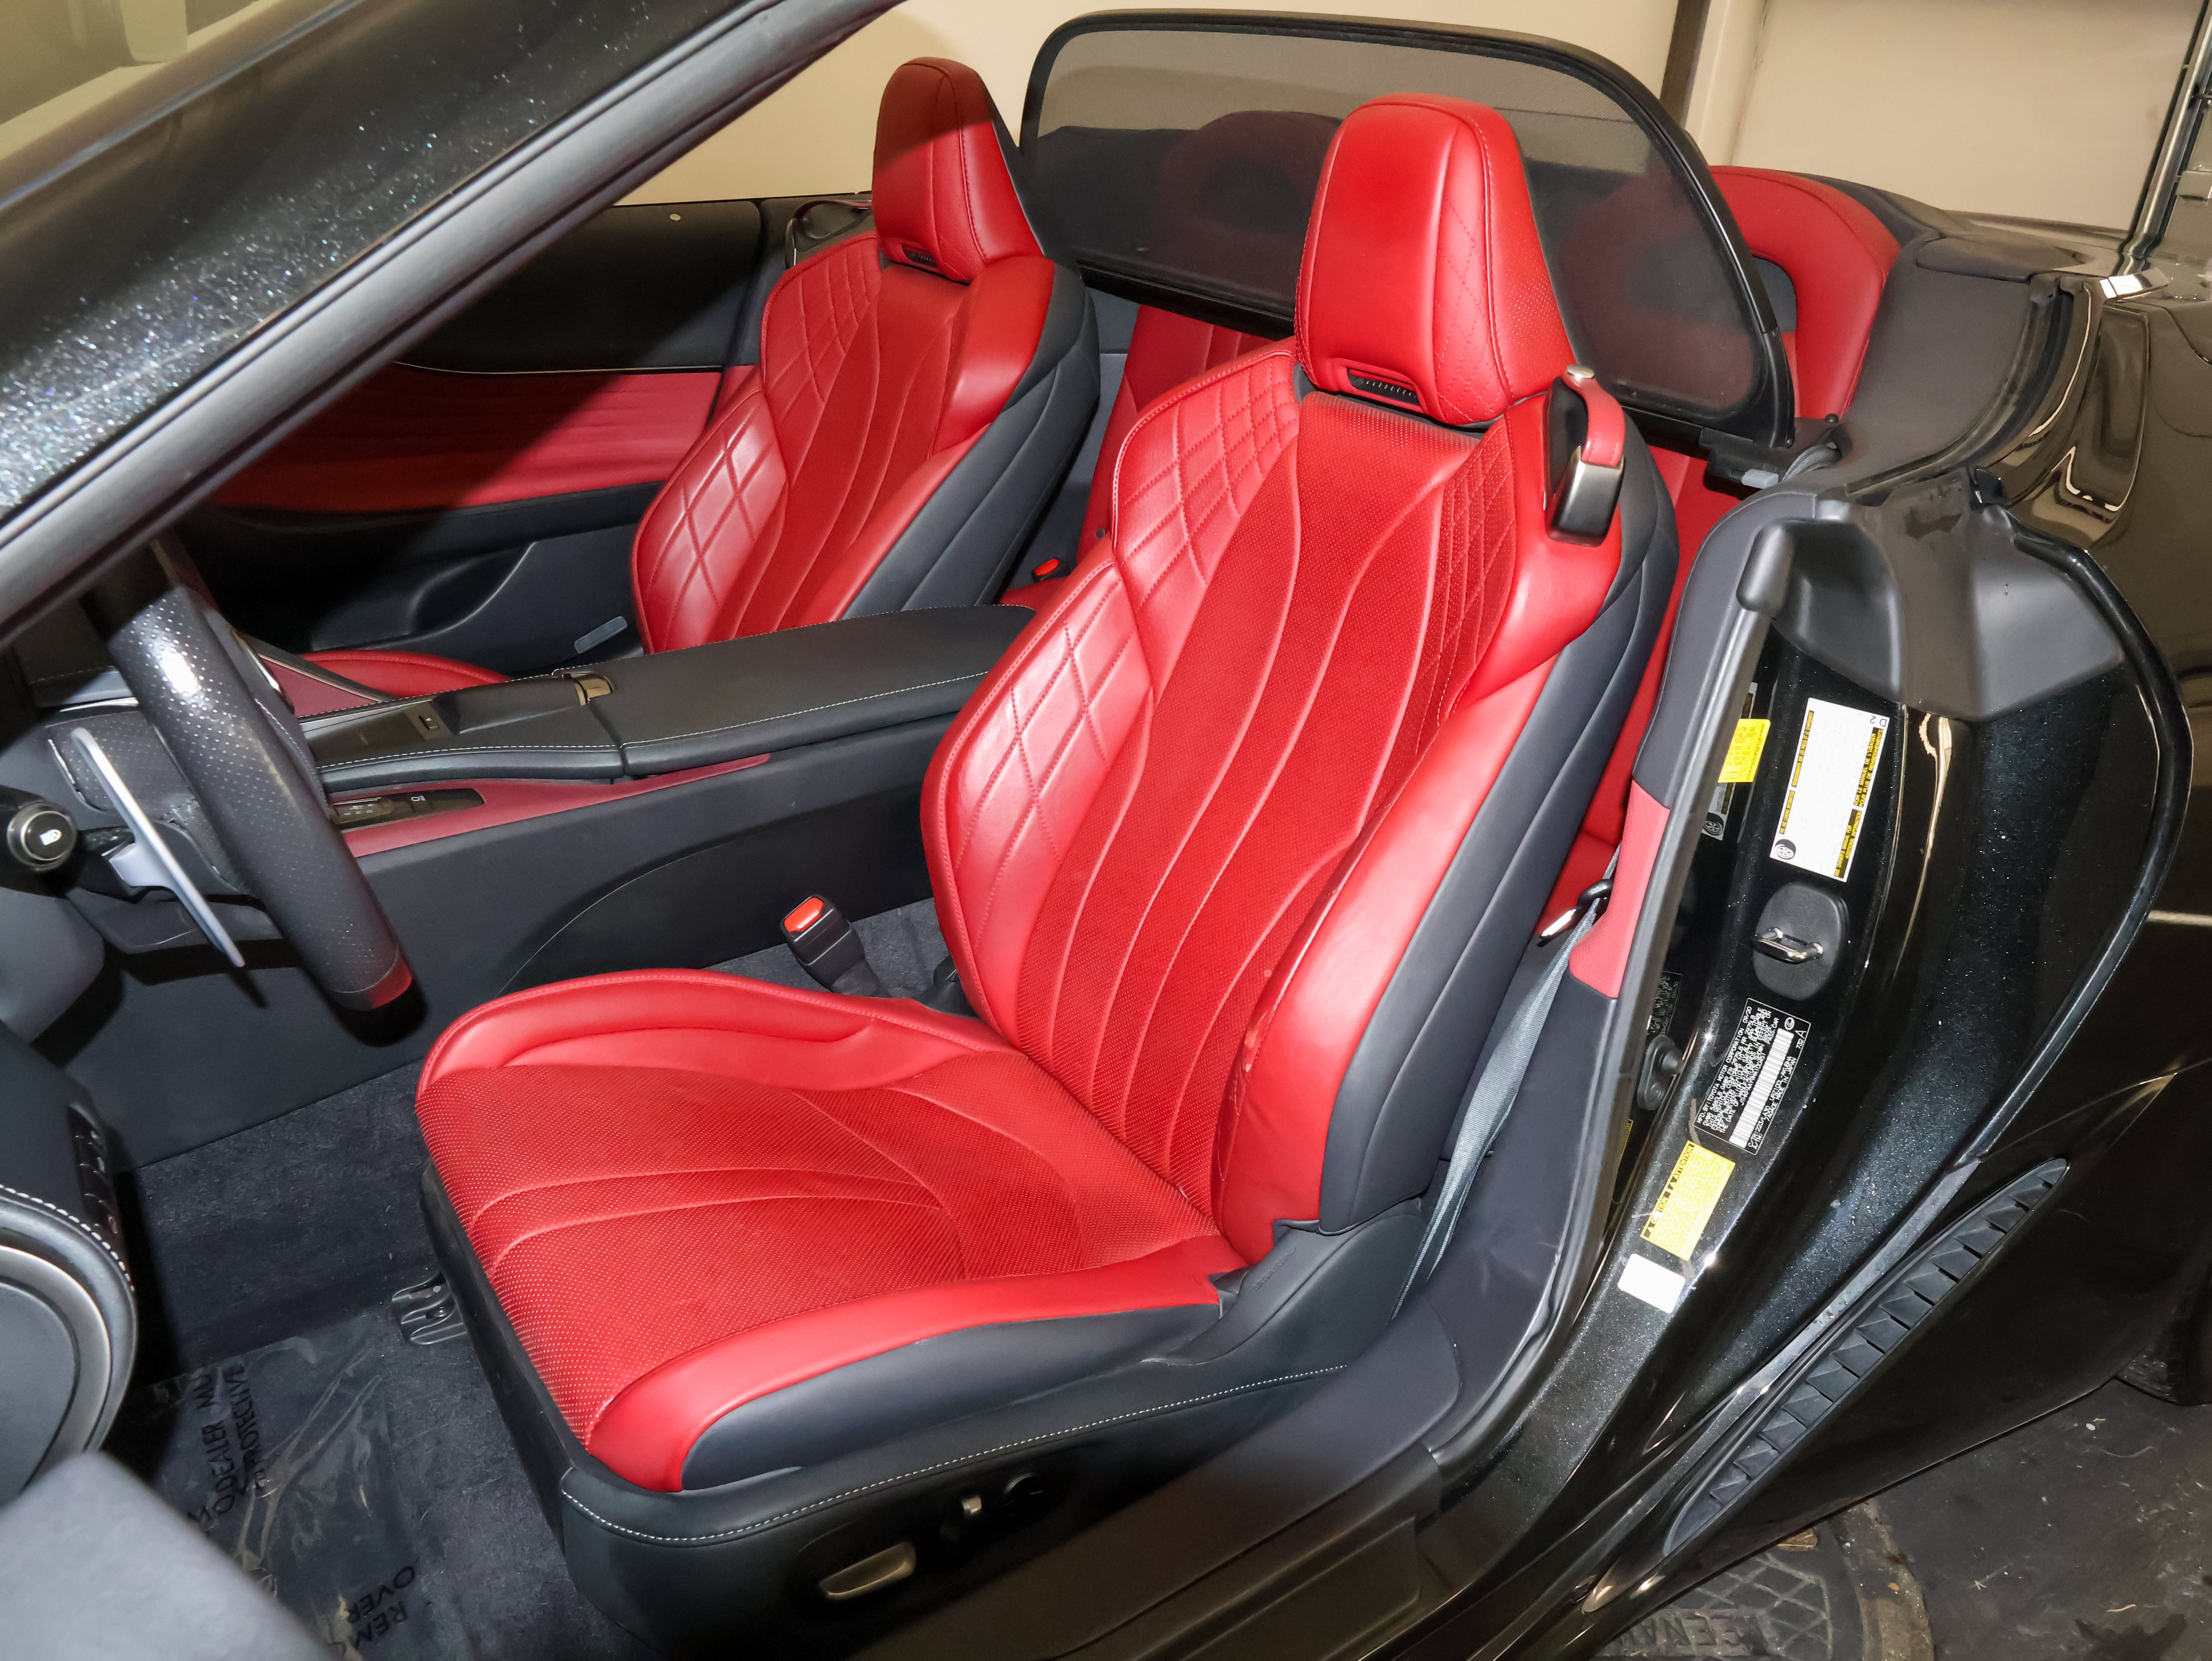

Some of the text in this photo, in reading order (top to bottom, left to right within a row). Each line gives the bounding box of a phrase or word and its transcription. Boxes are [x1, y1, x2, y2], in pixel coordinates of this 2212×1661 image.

[1868, 728, 1883, 771] RENSEIGNEMENTS
[1869, 715, 1876, 724] 2
[1859, 765, 1868, 786] MANUEL
[1866, 733, 1877, 756] L'USAGER
[1845, 810, 1862, 859] ADDITIONAL INFORMATION
[1702, 1111, 1713, 1126] GVWR
[1719, 1075, 1730, 1090] GAWR
[1726, 1066, 1734, 1075] FR
[1730, 1045, 1744, 1066] 2975LB
[1740, 1035, 1748, 1044] RR
[1744, 1014, 1756, 1035] 2975LB
[1706, 1113, 1717, 1128] THIS
[1713, 1089, 1729, 1113] VEHICLE
[1725, 1062, 1741, 1089] CONFORMS
[1738, 1053, 1745, 1061] TO
[1747, 1006, 1763, 1040] APPLICABLE
[1715, 1116, 1727, 1132] THEFT
[1724, 1081, 1743, 1114] PREVENTION
[1740, 1050, 1757, 1081] STANDARDS
[1757, 1020, 1769, 1041] EFFECT
[1765, 1010, 1773, 1019] ON
[1716, 1063, 1729, 1082] MOTOR
[1725, 1026, 1745, 1063] CORPORATION
[1742, 1005, 1753, 1024] 09/20
[1793, 1026, 1808, 1050] 732 A
[1710, 1108, 1725, 1130] FEDERAL
[1722, 1088, 1735, 1106] MOTOR
[1731, 1065, 1745, 1088] VEHICLE
[1720, 1123, 1729, 1134] THE
[1725, 1108, 1736, 1122] DATE
[1737, 1062, 1757, 1098] MANUFACTURE
[1754, 1043, 1765, 1061] SHOWN
[1752, 1132, 1763, 1149] A/TM:
[1774, 1085, 1785, 1100] MADE
[1782, 1075, 1789, 1084] IN
[1786, 1056, 1797, 1075] JAPAN
[1672, 1144, 1694, 1180] ATTENTION
[1650, 1196, 1668, 1225] CTION
[223, 1364, 263, 1472] PROTECTIVE
[202, 1420, 237, 1493] DEALER
